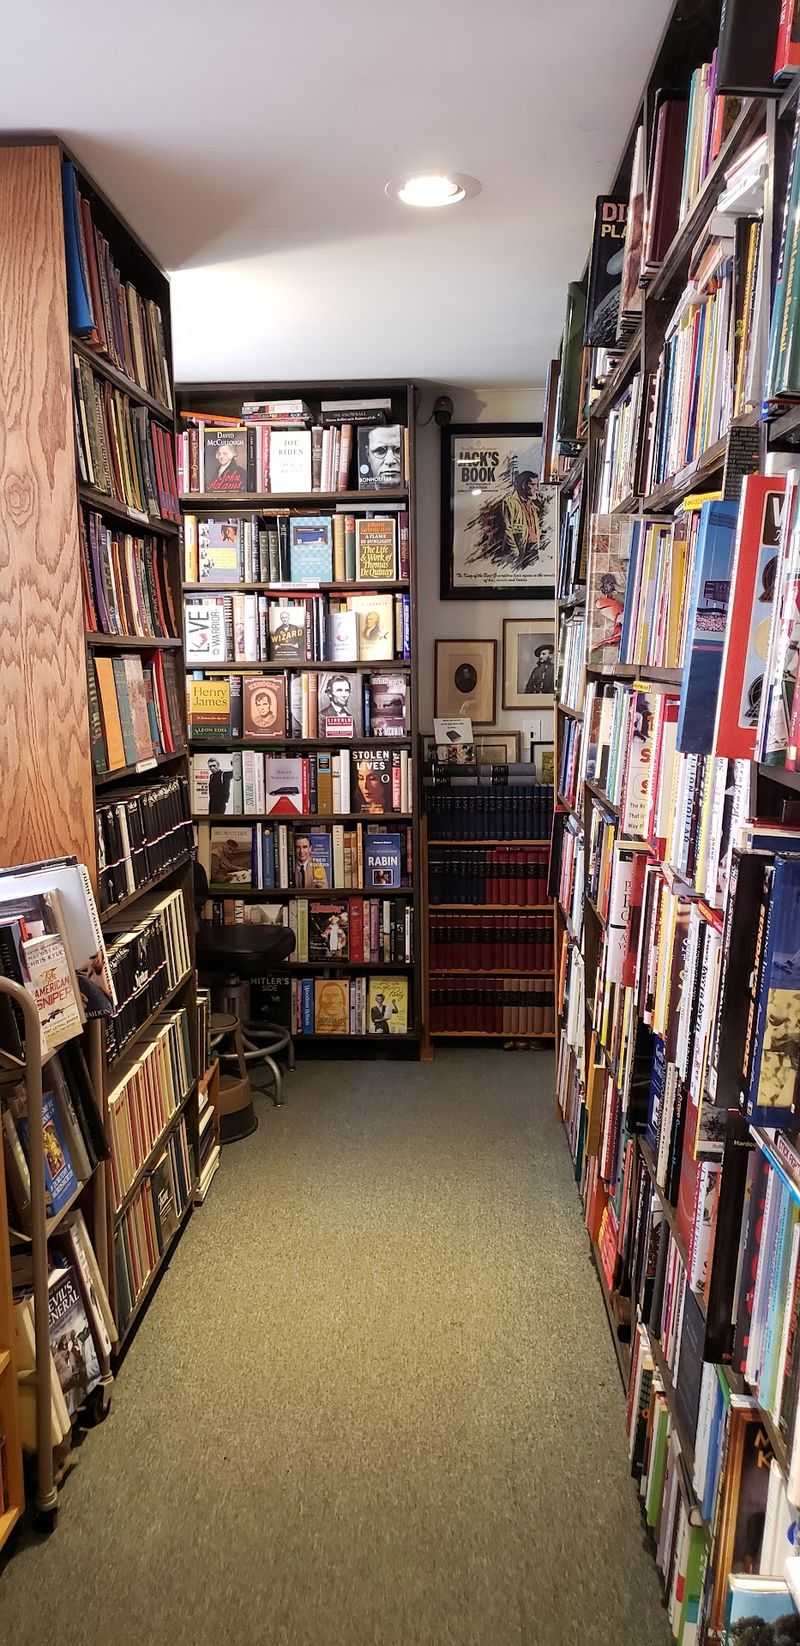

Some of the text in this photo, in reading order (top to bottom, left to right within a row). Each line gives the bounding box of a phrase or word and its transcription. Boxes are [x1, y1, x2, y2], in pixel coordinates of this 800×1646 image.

[458, 452, 499, 466] JACK'S
[461, 468, 495, 482] BOOK
[193, 687, 226, 697] Henry
[193, 696, 228, 706] James
[352, 751, 389, 759] STOLEN
[357, 762, 386, 770] LIVES
[368, 857, 397, 866] RABIN
[34, 976, 70, 999] AMERICAN
[36, 990, 72, 1010] SNIPER
[49, 1280, 72, 1312] EVIL'S
[49, 1290, 80, 1326] NERAL
